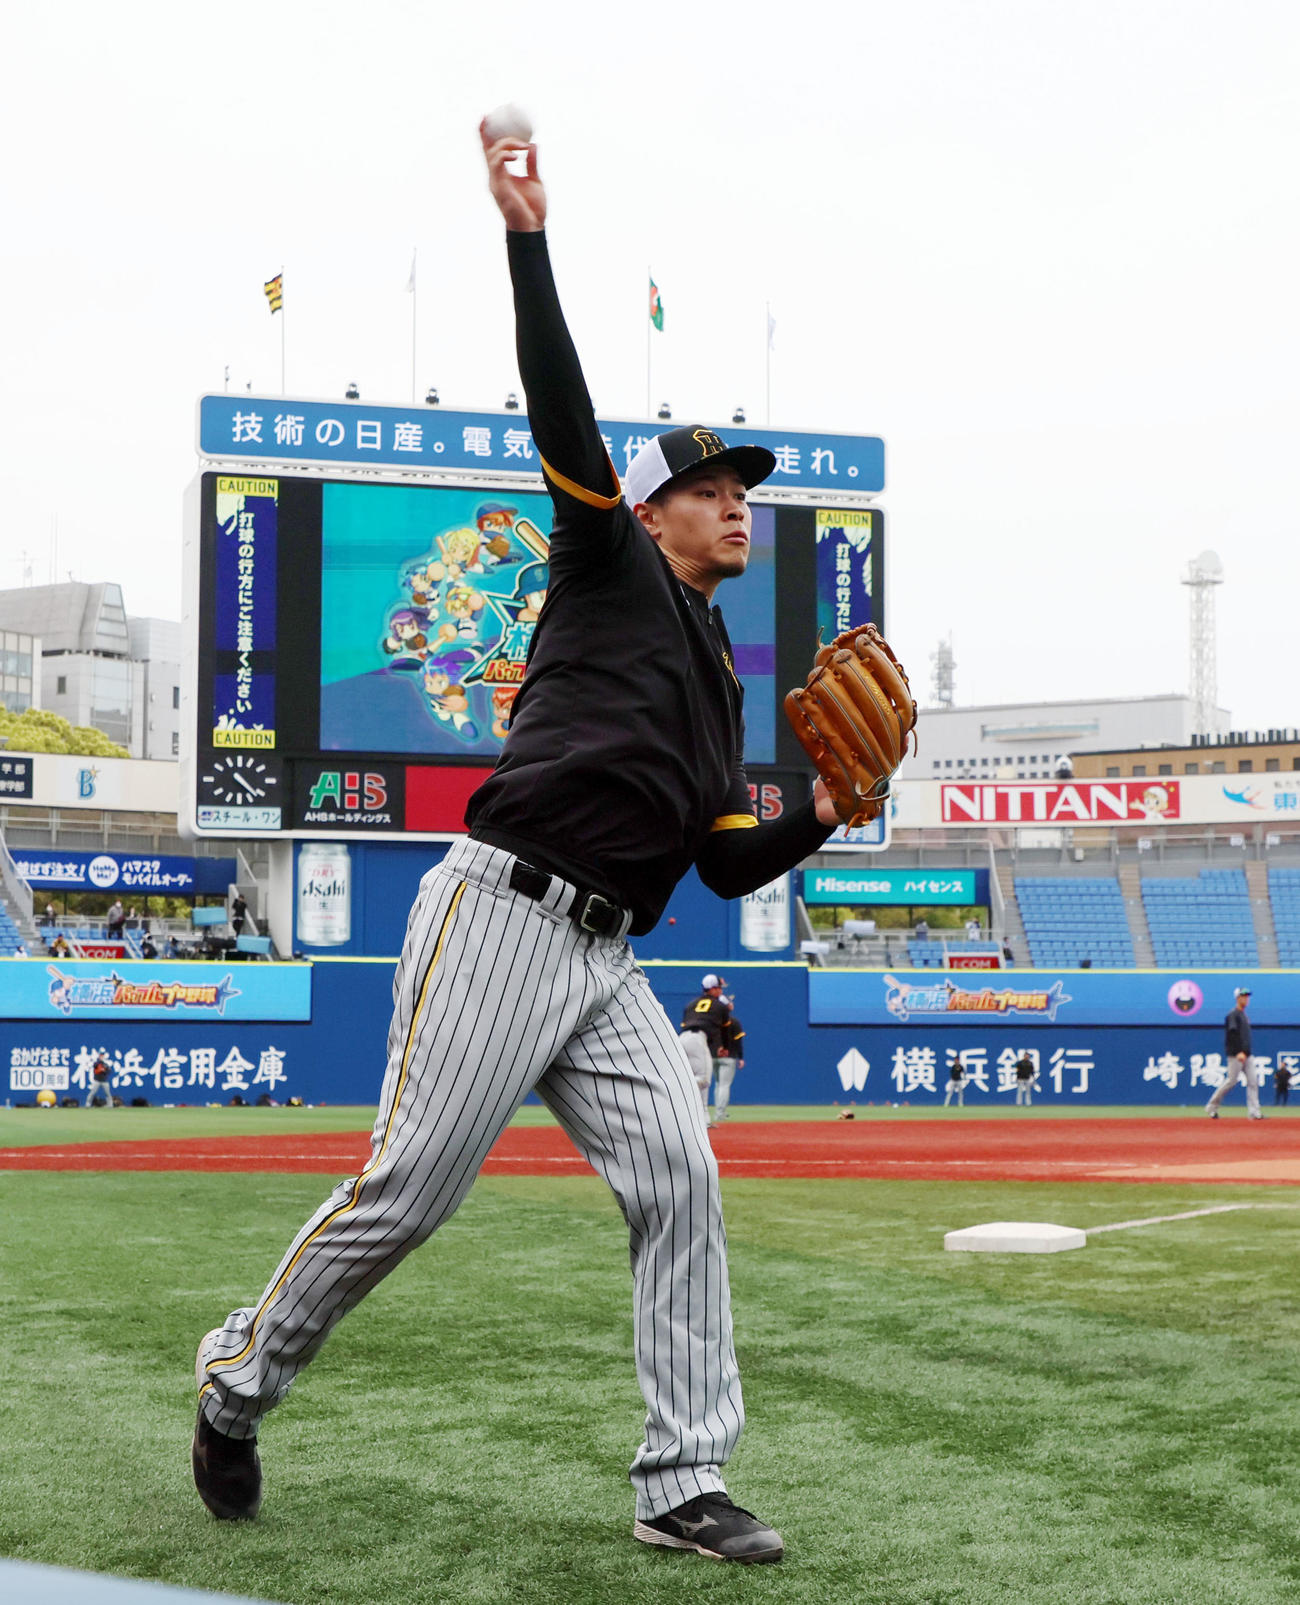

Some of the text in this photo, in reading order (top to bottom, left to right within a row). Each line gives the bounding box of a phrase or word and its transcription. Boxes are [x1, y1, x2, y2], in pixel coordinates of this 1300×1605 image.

[219, 480, 276, 494] CAUTION
[818, 511, 869, 526] CAUTION
[836, 542, 852, 638] 打球の行方に
[236, 511, 255, 713] 打球の行方にご注意ください
[215, 732, 272, 747] CAUTION
[310, 771, 388, 811] AHS
[943, 783, 1128, 821] NITTAN
[304, 811, 391, 824] AHSホールディングス
[303, 880, 346, 897] Asahi
[815, 878, 963, 893] Hisense ハイセンス
[11, 1046, 71, 1066] おかげさまで
[891, 1046, 1095, 1093] 横浜銀行
